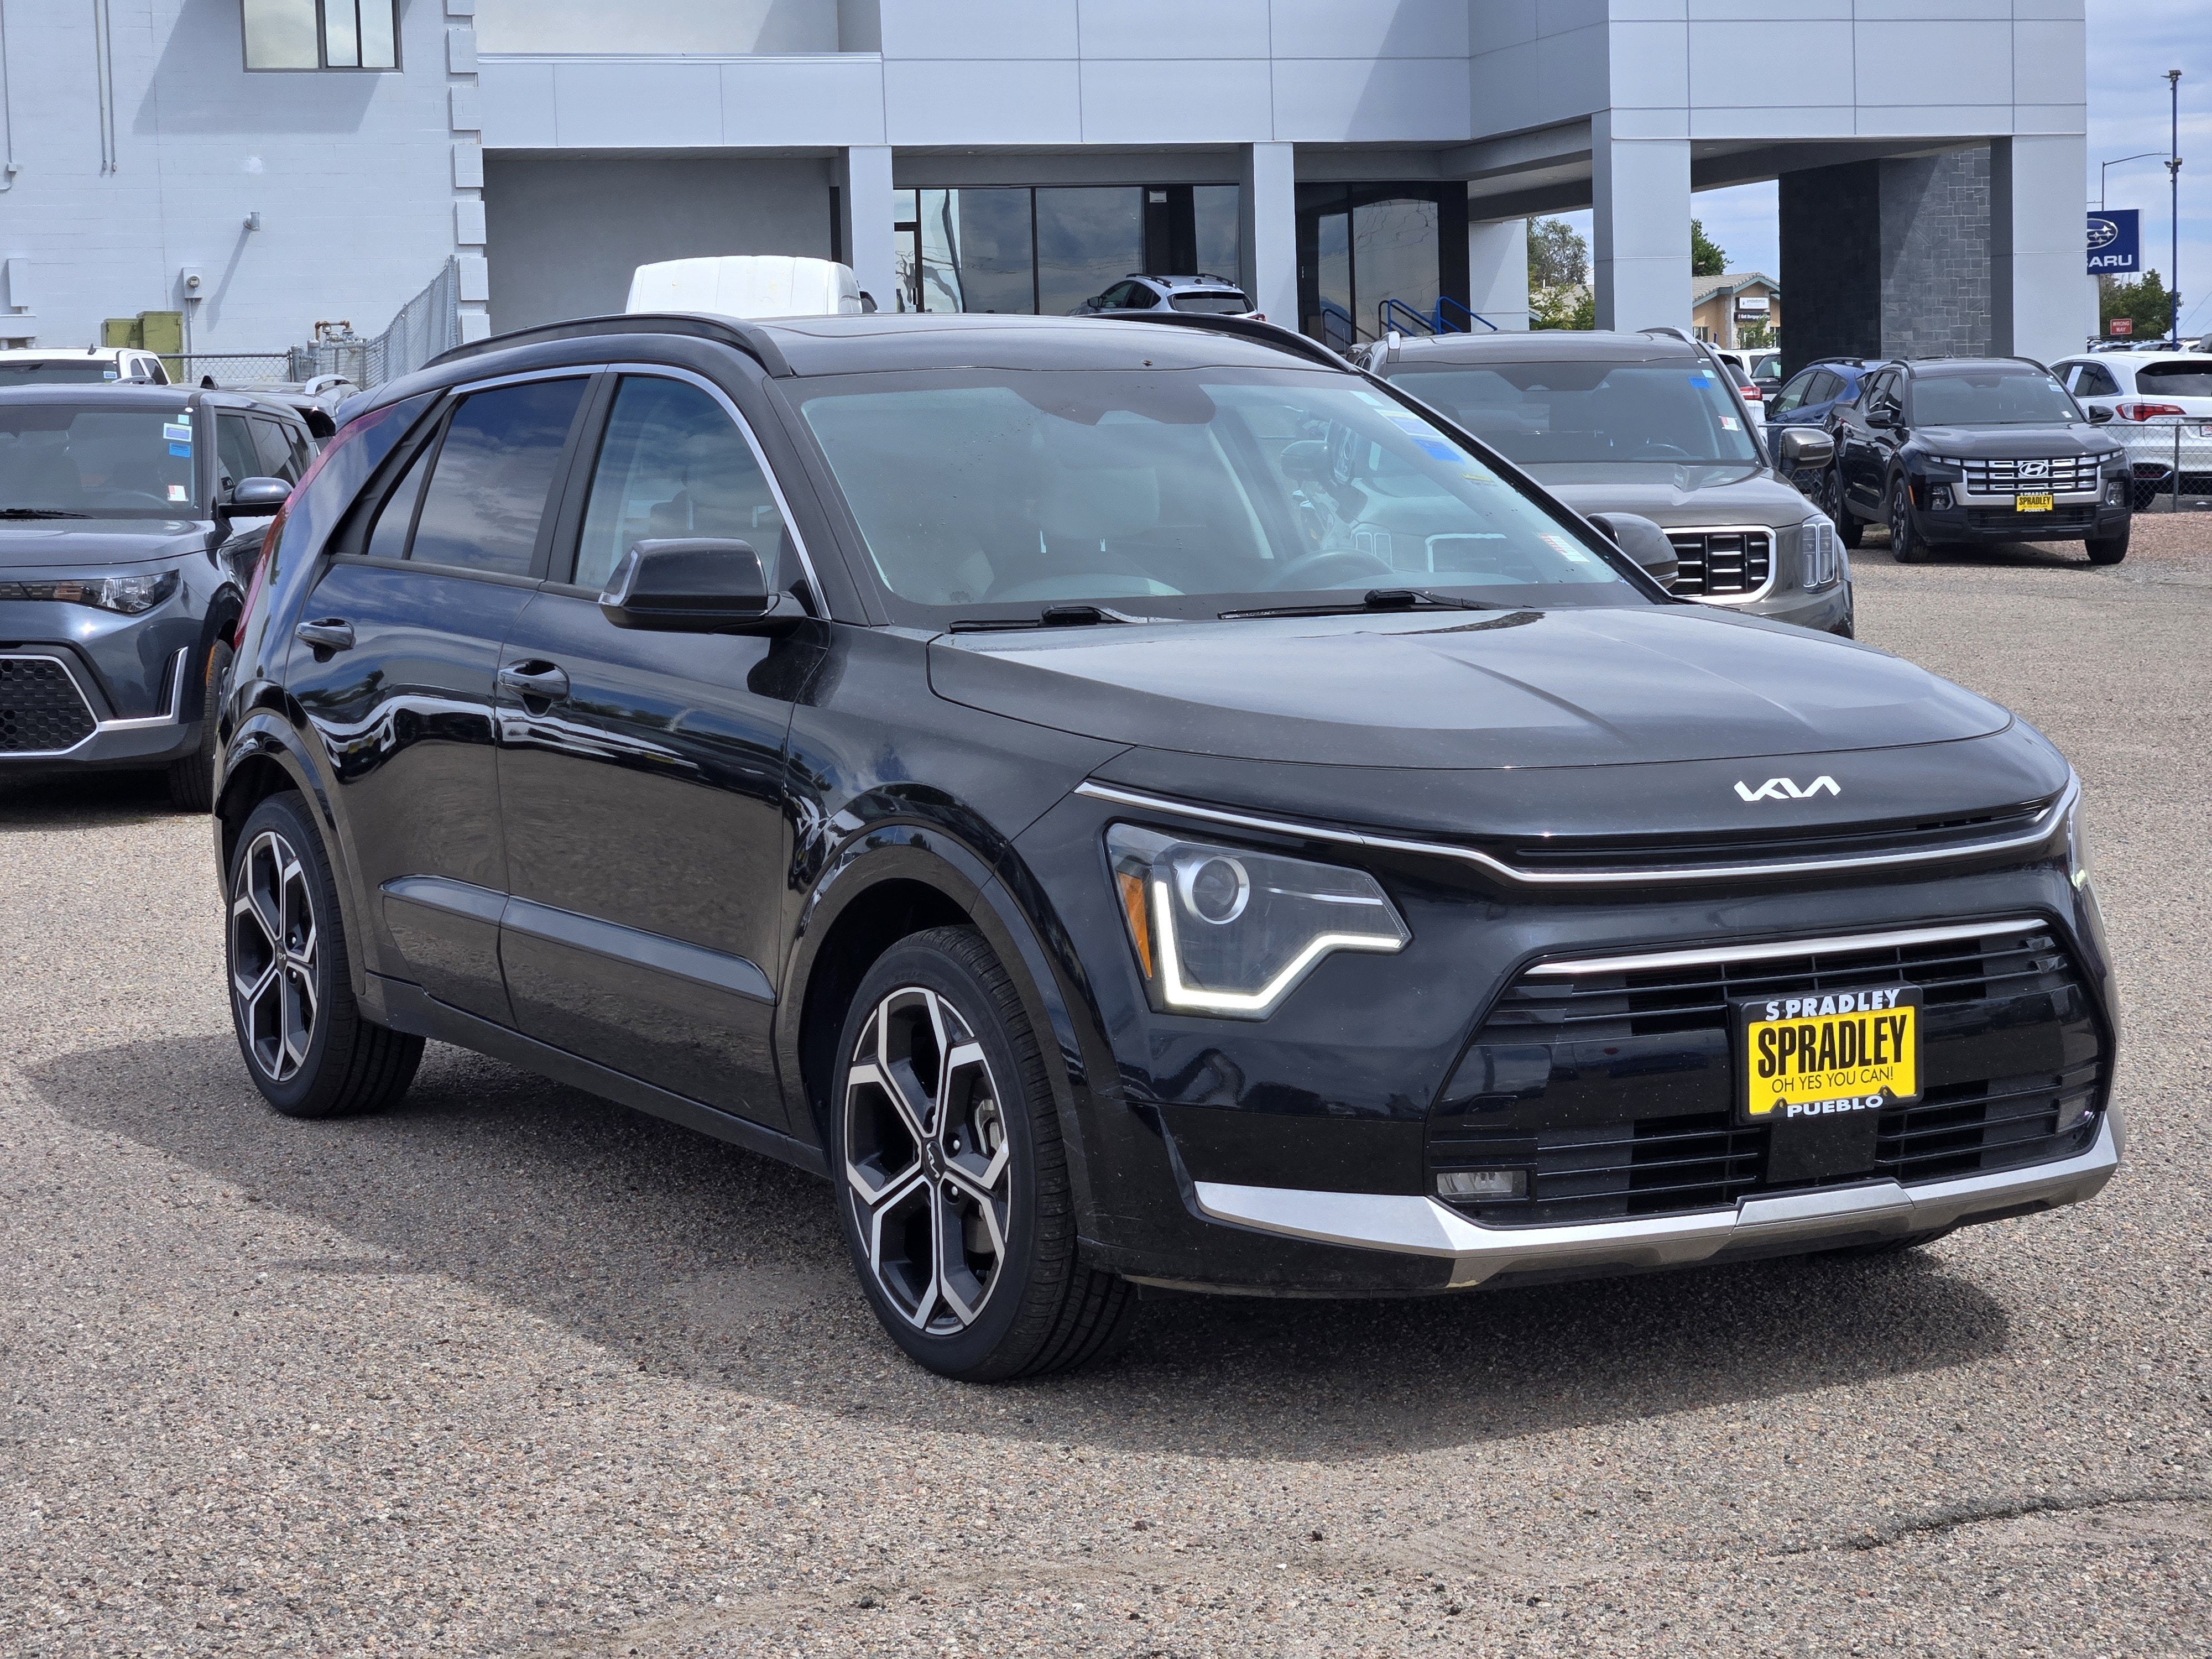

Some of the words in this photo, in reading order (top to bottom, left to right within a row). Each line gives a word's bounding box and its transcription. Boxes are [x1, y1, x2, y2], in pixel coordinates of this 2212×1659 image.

[2087, 254, 2132, 268] ARU
[2019, 496, 2051, 505] SPRADLEY
[1734, 775, 1841, 802] KIA
[1765, 988, 1900, 1021] SPRADLEY
[1758, 1015, 1907, 1078] SPRADLEY
[1772, 1077, 1794, 1093] OH
[1798, 1074, 1822, 1091] YES
[1826, 1071, 1855, 1087] YOU
[1860, 1066, 1893, 1083] CAN!
[1787, 1095, 1884, 1118] PUEBLO
